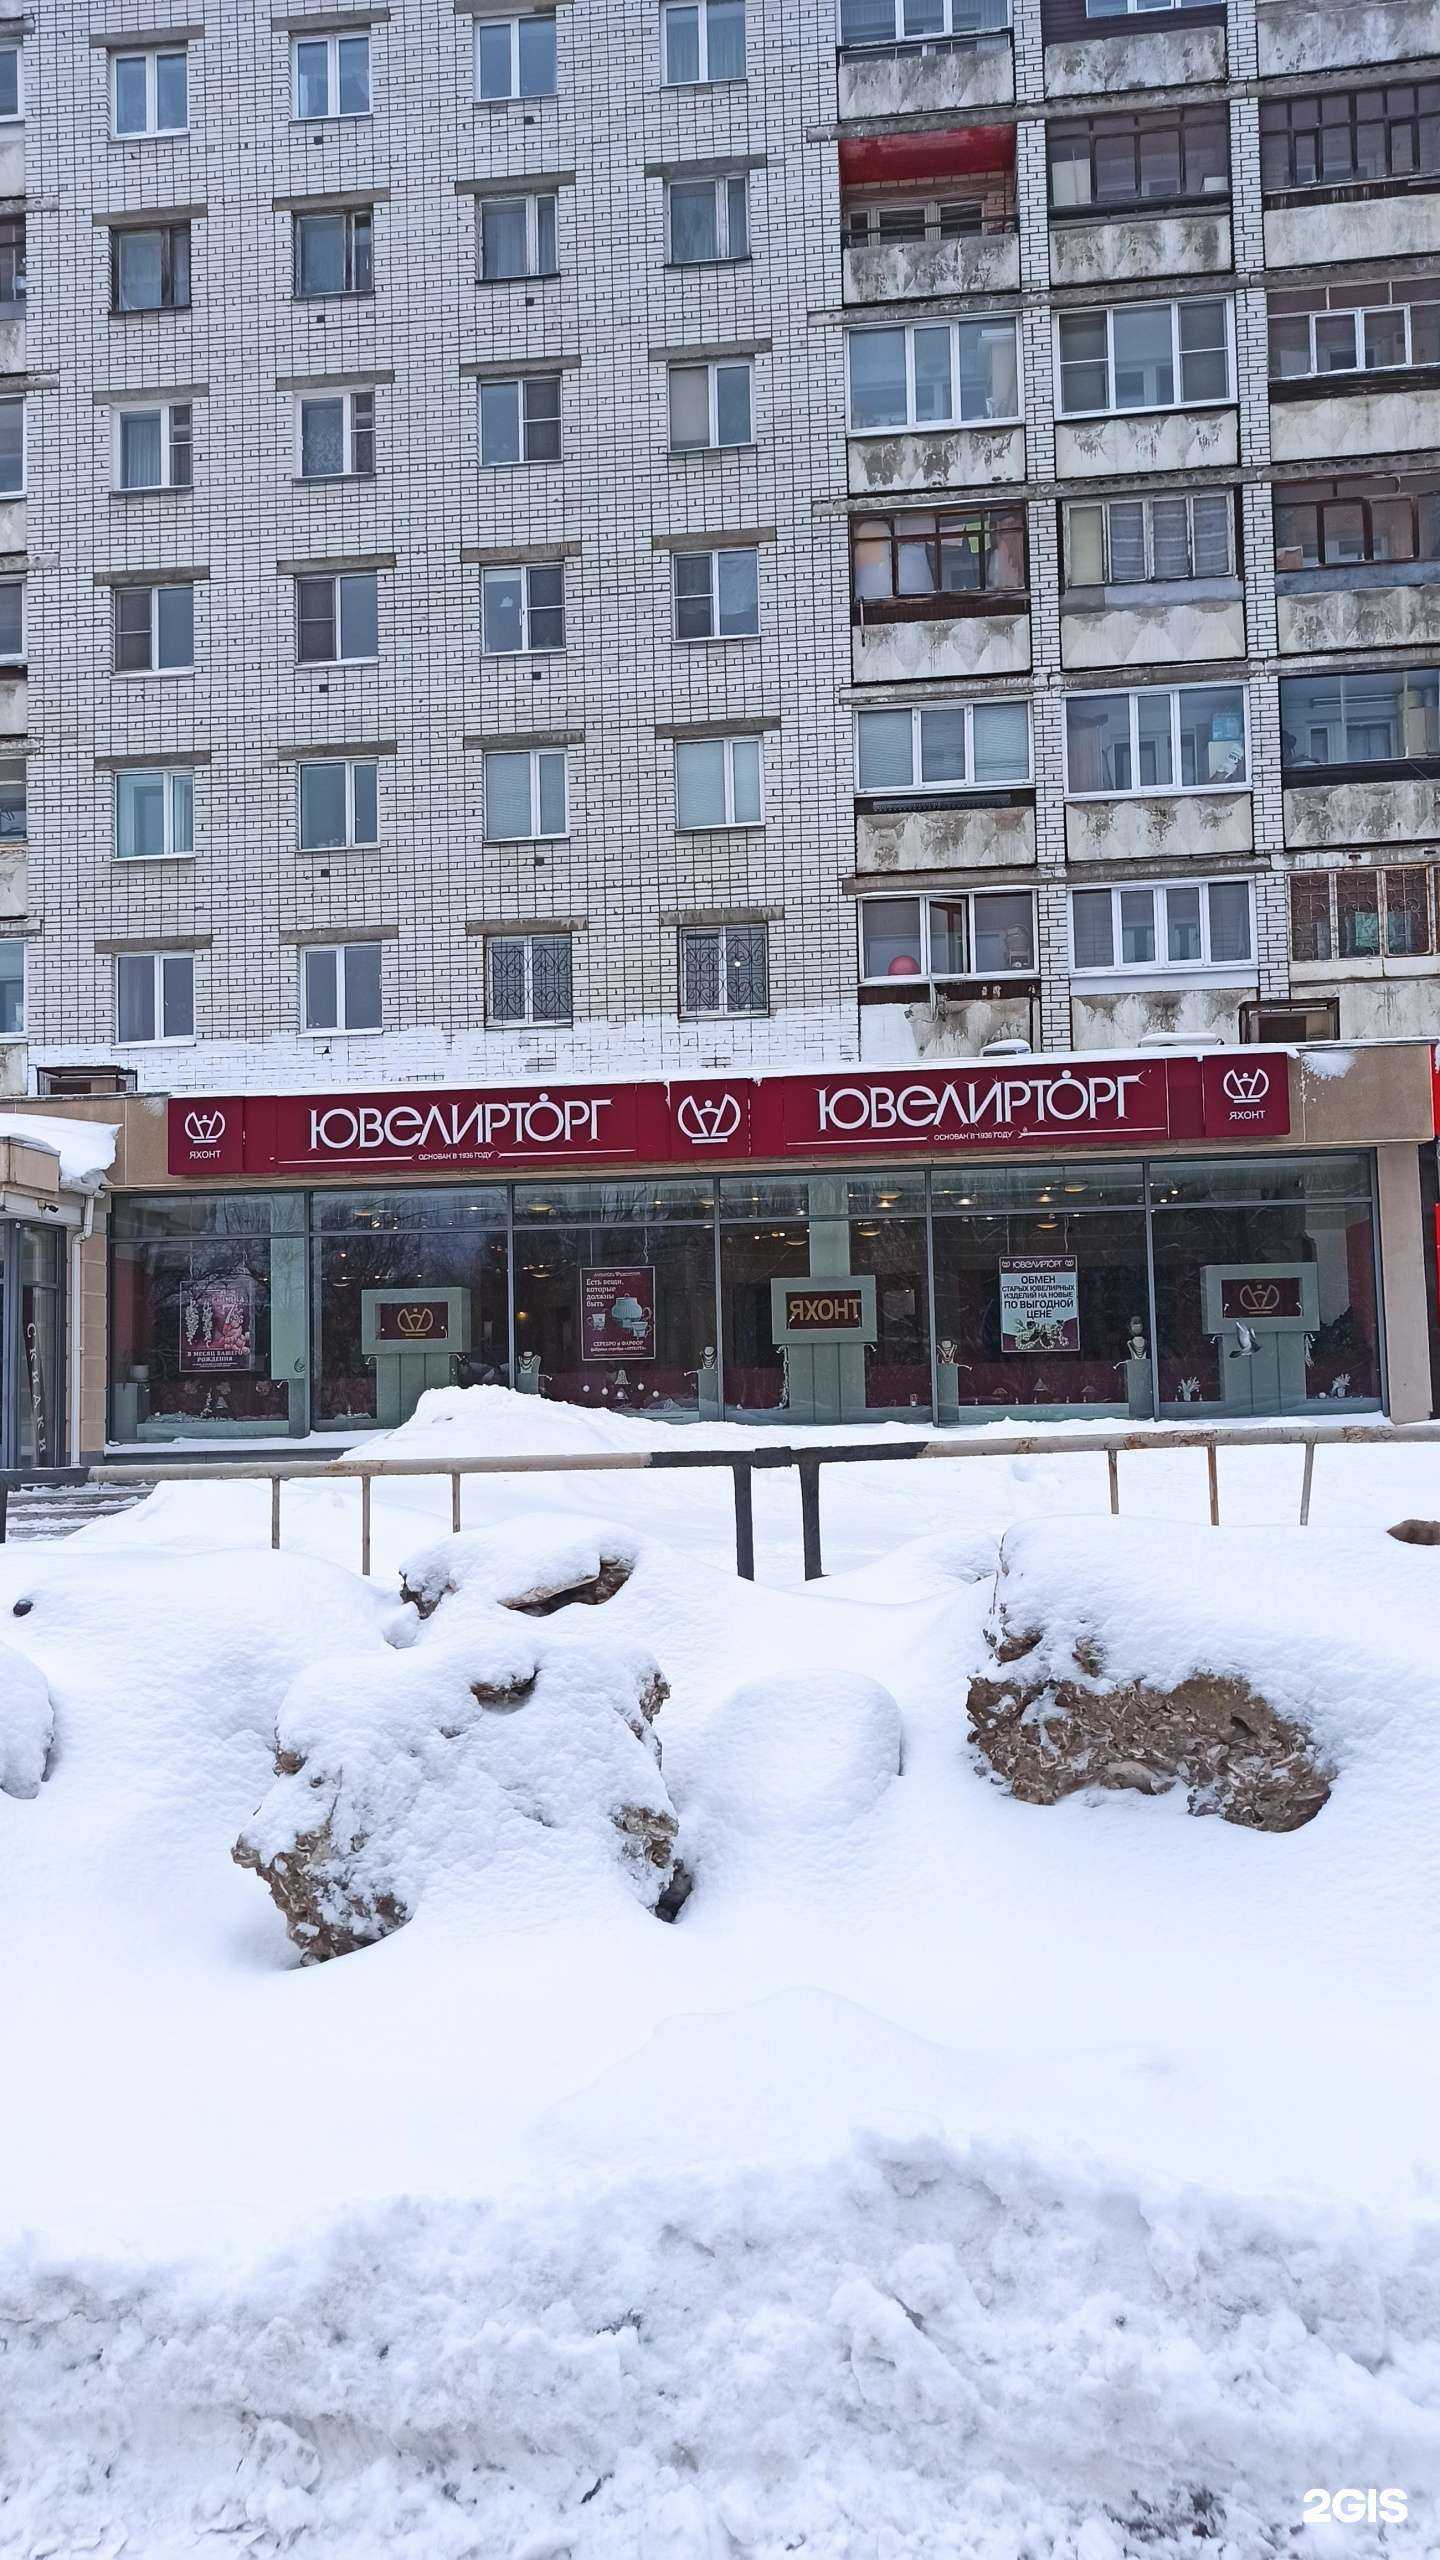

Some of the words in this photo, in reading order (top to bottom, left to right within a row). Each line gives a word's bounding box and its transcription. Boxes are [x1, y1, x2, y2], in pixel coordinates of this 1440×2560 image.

[1229, 1110, 1266, 1120] ЯХОНТ
[993, 1130, 1013, 1140] ГОДУ
[189, 1150, 222, 1160] ЯХОНТ
[418, 1153, 452, 1161] ОСНОВАН
[474, 1151, 493, 1160] ГОДУ
[1021, 1275, 1056, 1285] ОБМЕН
[1030, 1284, 1075, 1292] ЮВЕЛИРНЫХ
[1004, 1300, 1018, 1309] ПО
[1020, 1298, 1074, 1309] ВЫГОДНОЙ
[790, 1299, 863, 1321] ЯХОНТ
[1026, 1310, 1053, 1320] ЦЕНЕ
